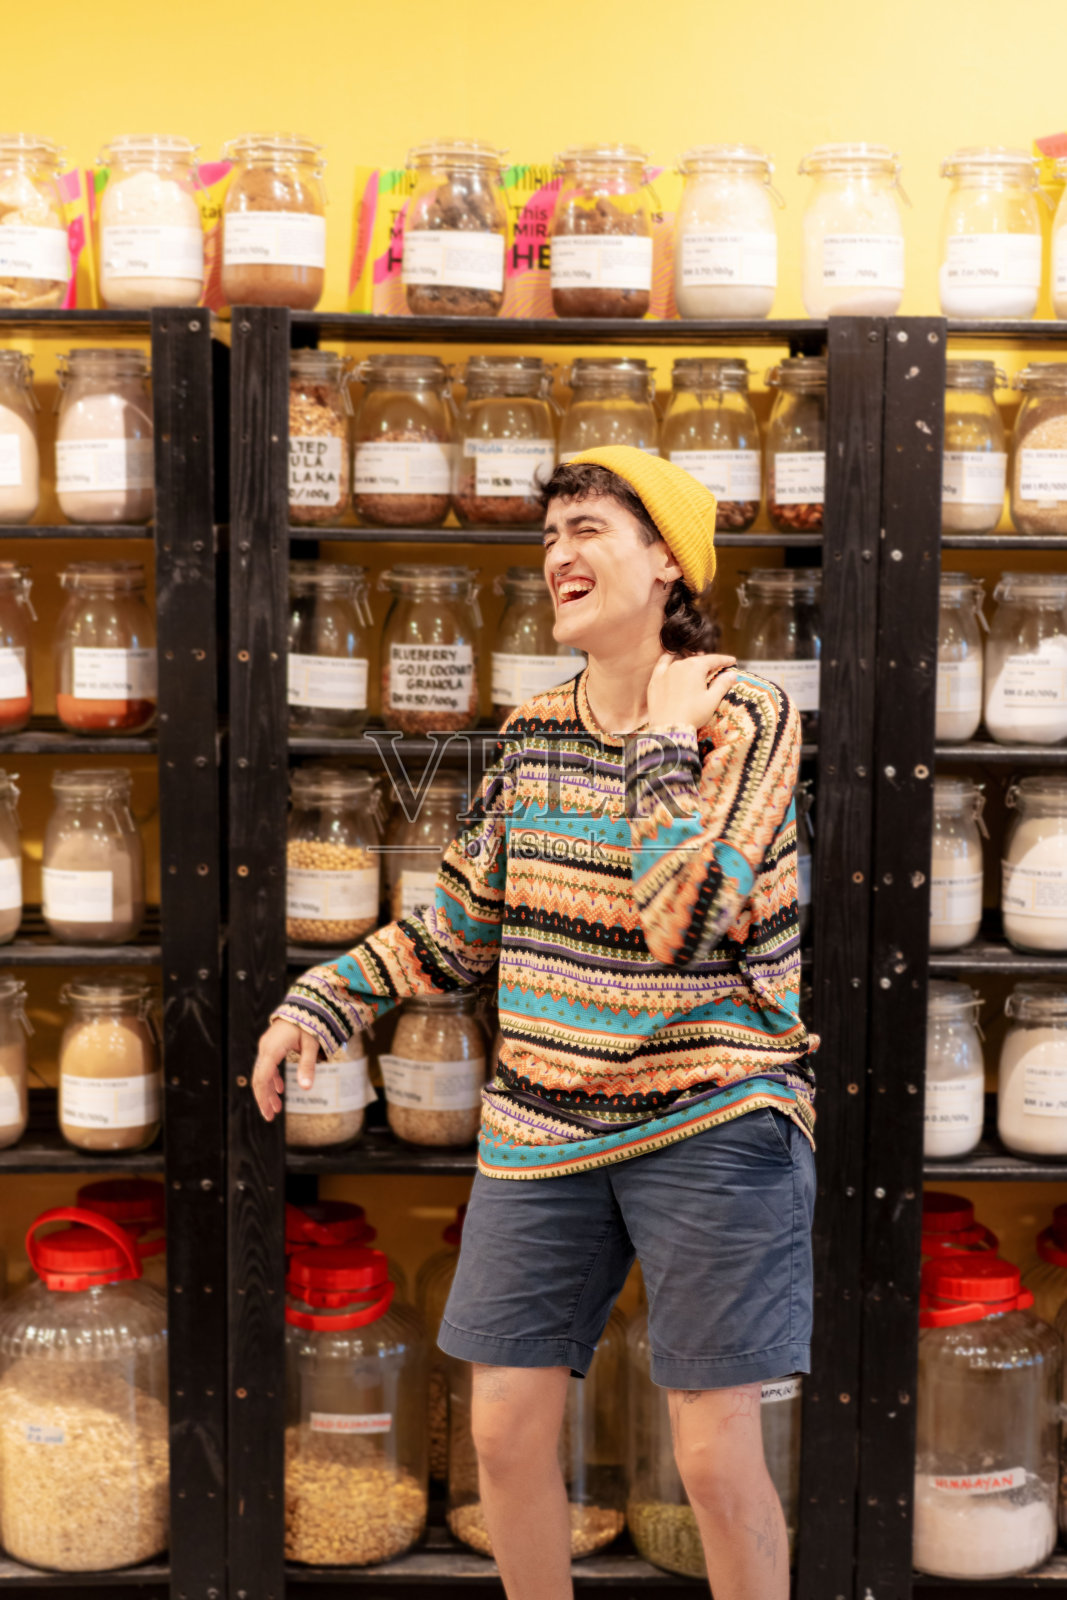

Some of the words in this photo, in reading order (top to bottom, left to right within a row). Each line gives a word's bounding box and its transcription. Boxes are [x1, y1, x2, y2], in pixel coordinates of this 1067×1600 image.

[514, 205, 547, 221] This
[514, 223, 550, 237] MIR
[392, 648, 458, 661] BLUEBERRY
[397, 664, 426, 677] GOJI
[429, 664, 473, 677] COCONUT
[406, 679, 464, 691] GRANOLA
[934, 1473, 1014, 1492] HIMALAYAN
